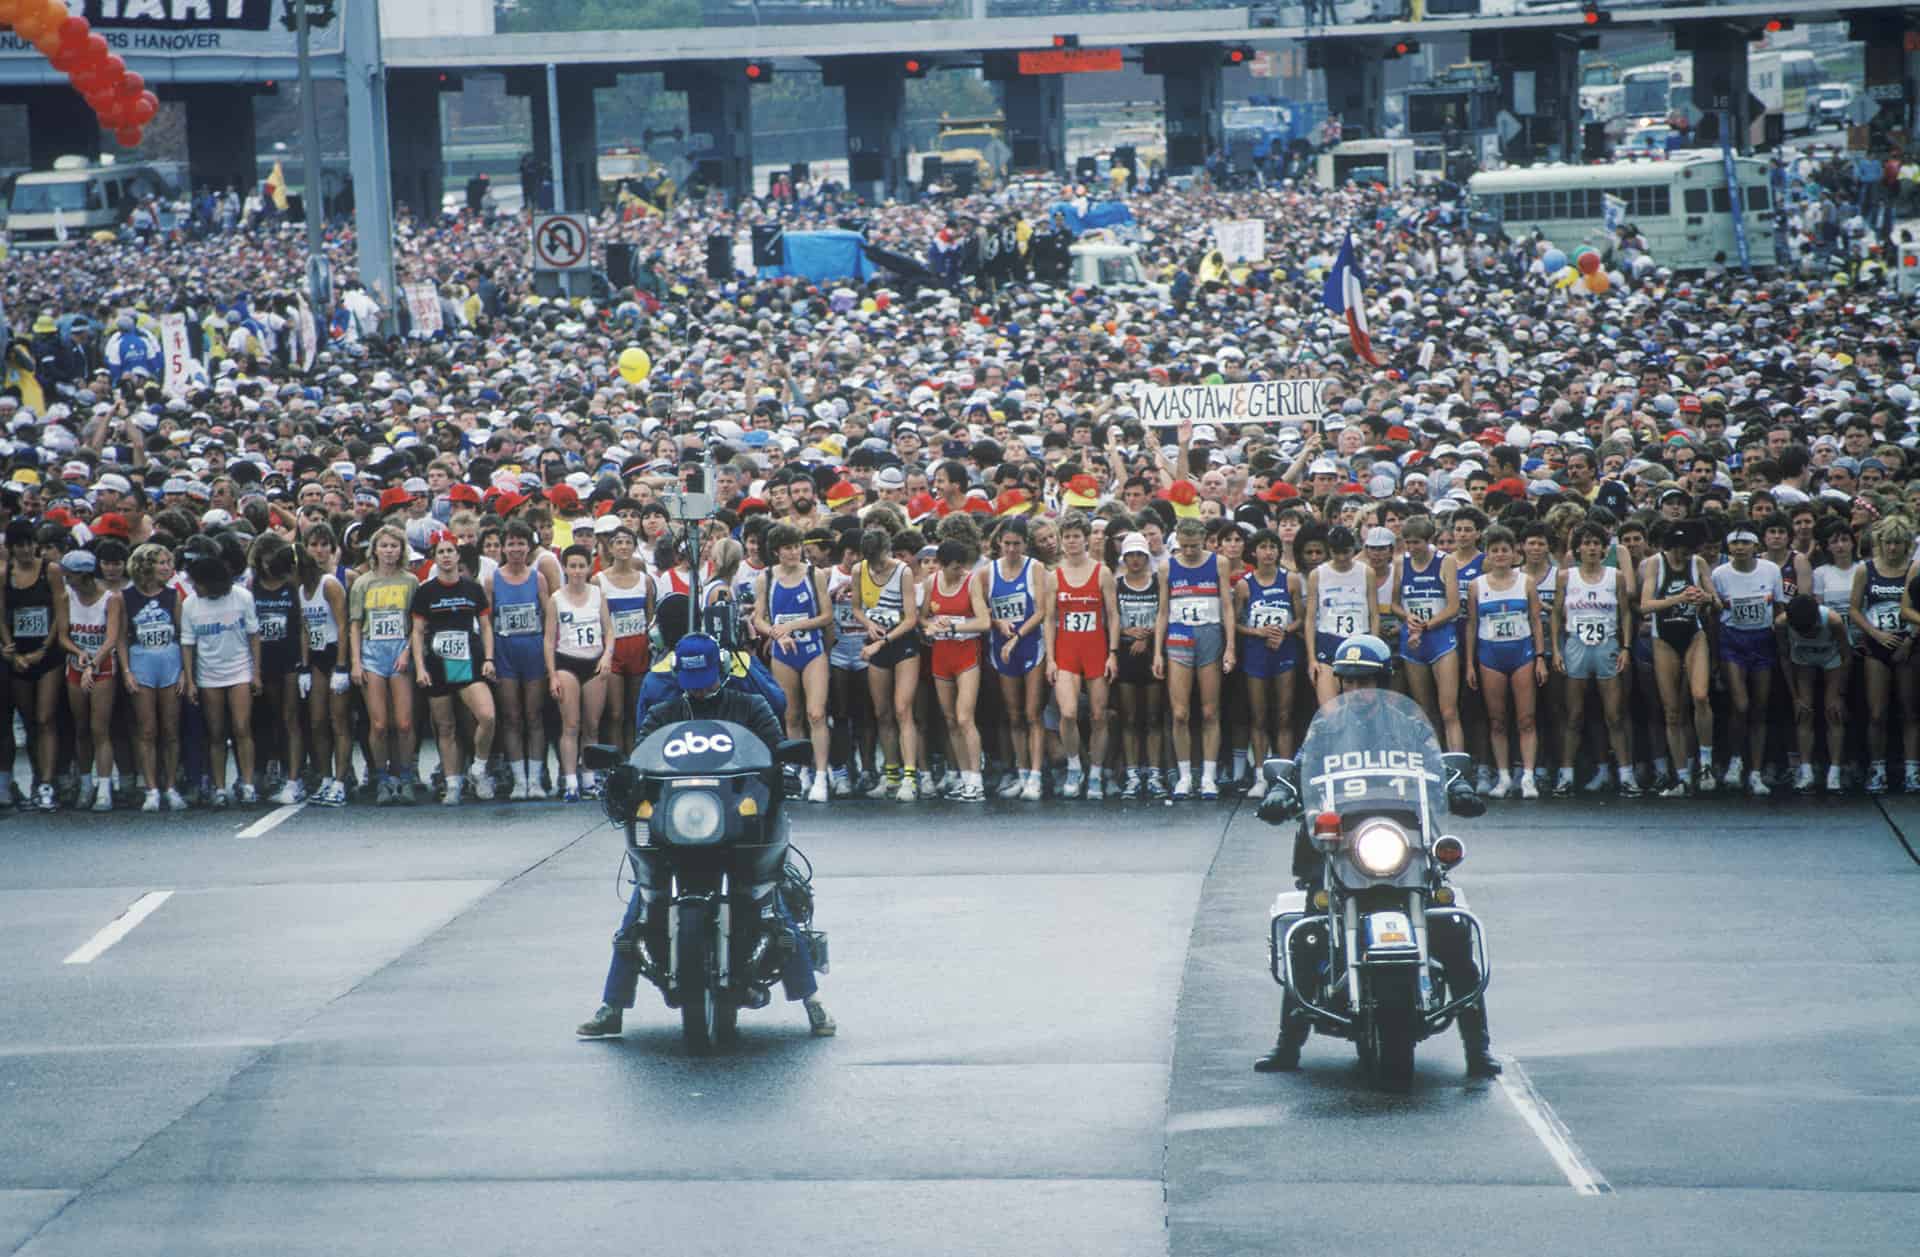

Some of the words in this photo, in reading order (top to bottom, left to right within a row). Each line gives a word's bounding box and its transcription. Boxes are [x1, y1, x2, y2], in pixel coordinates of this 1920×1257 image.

[134, 33, 221, 50] HANOVER
[1064, 612, 1091, 631] F37
[1182, 607, 1201, 622] F1
[1336, 616, 1354, 634] F3
[1577, 623, 1605, 641] F29
[577, 628, 595, 646] F6
[664, 731, 734, 758] abc
[1324, 750, 1425, 773] POLICE
